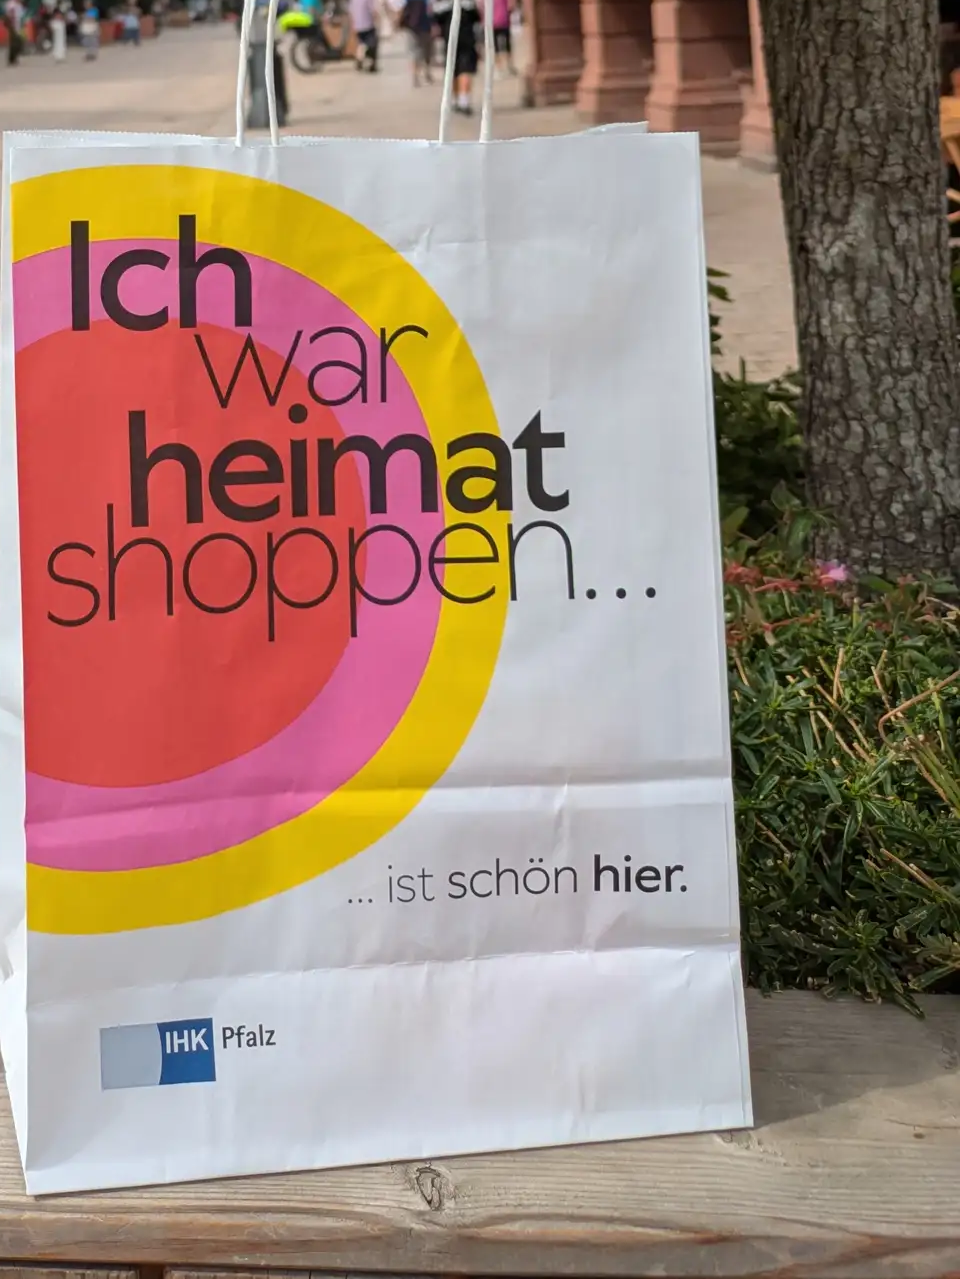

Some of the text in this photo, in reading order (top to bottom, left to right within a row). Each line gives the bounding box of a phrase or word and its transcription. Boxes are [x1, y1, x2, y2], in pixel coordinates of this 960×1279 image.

[70, 214, 253, 331] Ich
[194, 324, 429, 409] war
[127, 403, 570, 528] heimat
[388, 864, 435, 903] ist
[447, 857, 578, 899] schön
[593, 854, 688, 893] hier.
[165, 1023, 276, 1054] IHK Pfalz
